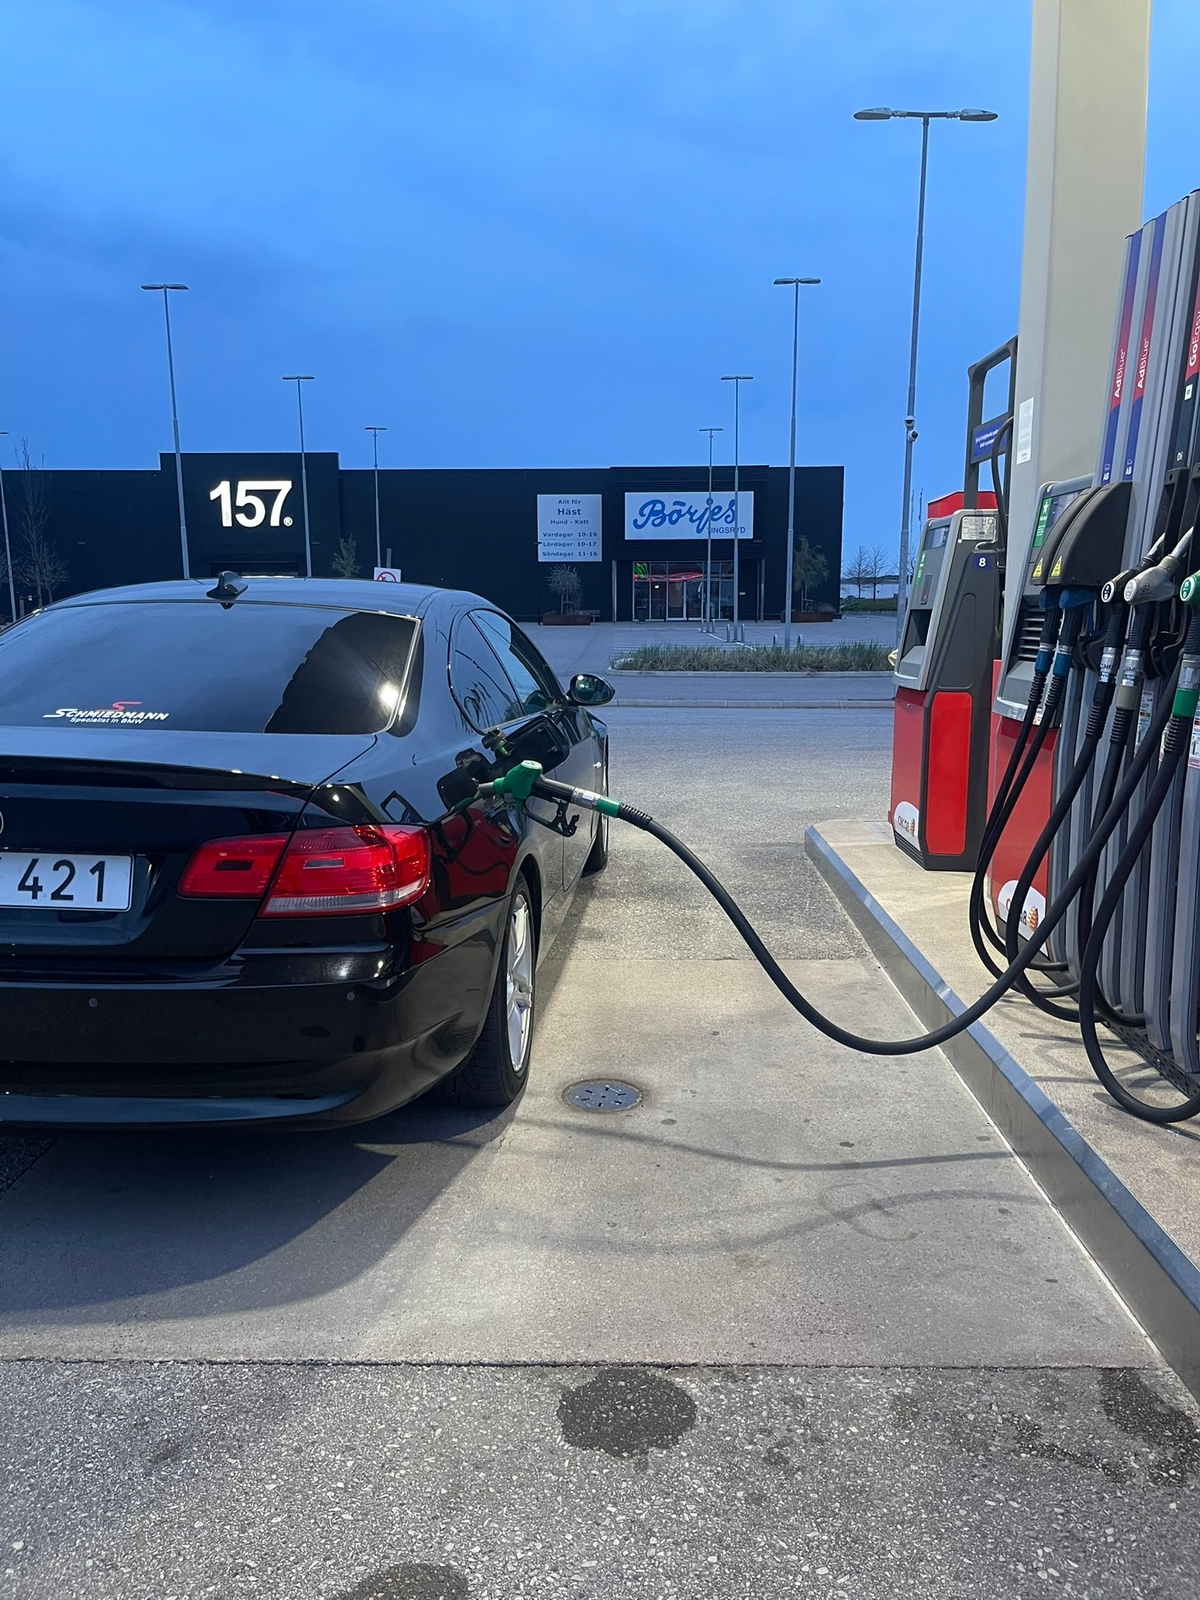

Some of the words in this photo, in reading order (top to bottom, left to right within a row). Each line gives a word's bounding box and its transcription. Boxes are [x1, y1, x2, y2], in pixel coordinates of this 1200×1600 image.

[557, 507, 582, 516] Häst
[978, 557, 987, 568] 8
[42, 708, 169, 720] SCHMIEDMANN
[17, 857, 106, 903] 421
